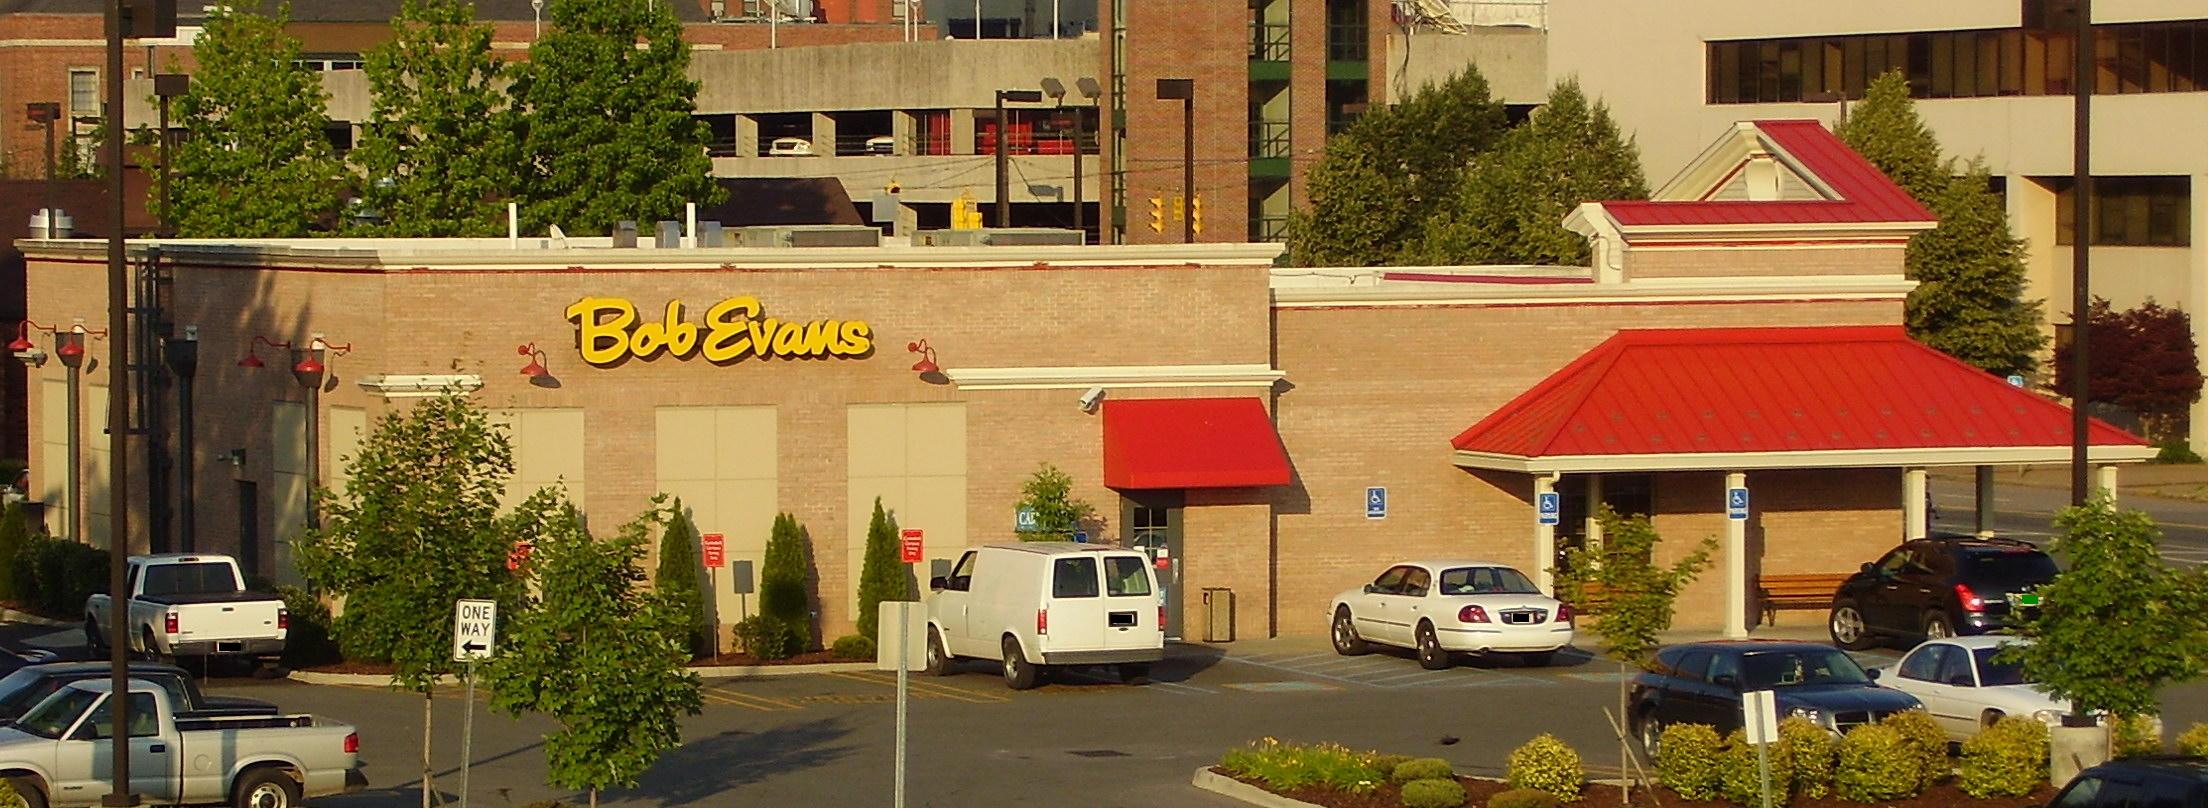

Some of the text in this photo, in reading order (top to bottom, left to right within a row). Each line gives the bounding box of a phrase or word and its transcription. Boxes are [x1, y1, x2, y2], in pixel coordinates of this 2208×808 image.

[565, 295, 870, 364] Bob Evans
[463, 605, 491, 620] ONE
[461, 622, 491, 636] WAY
